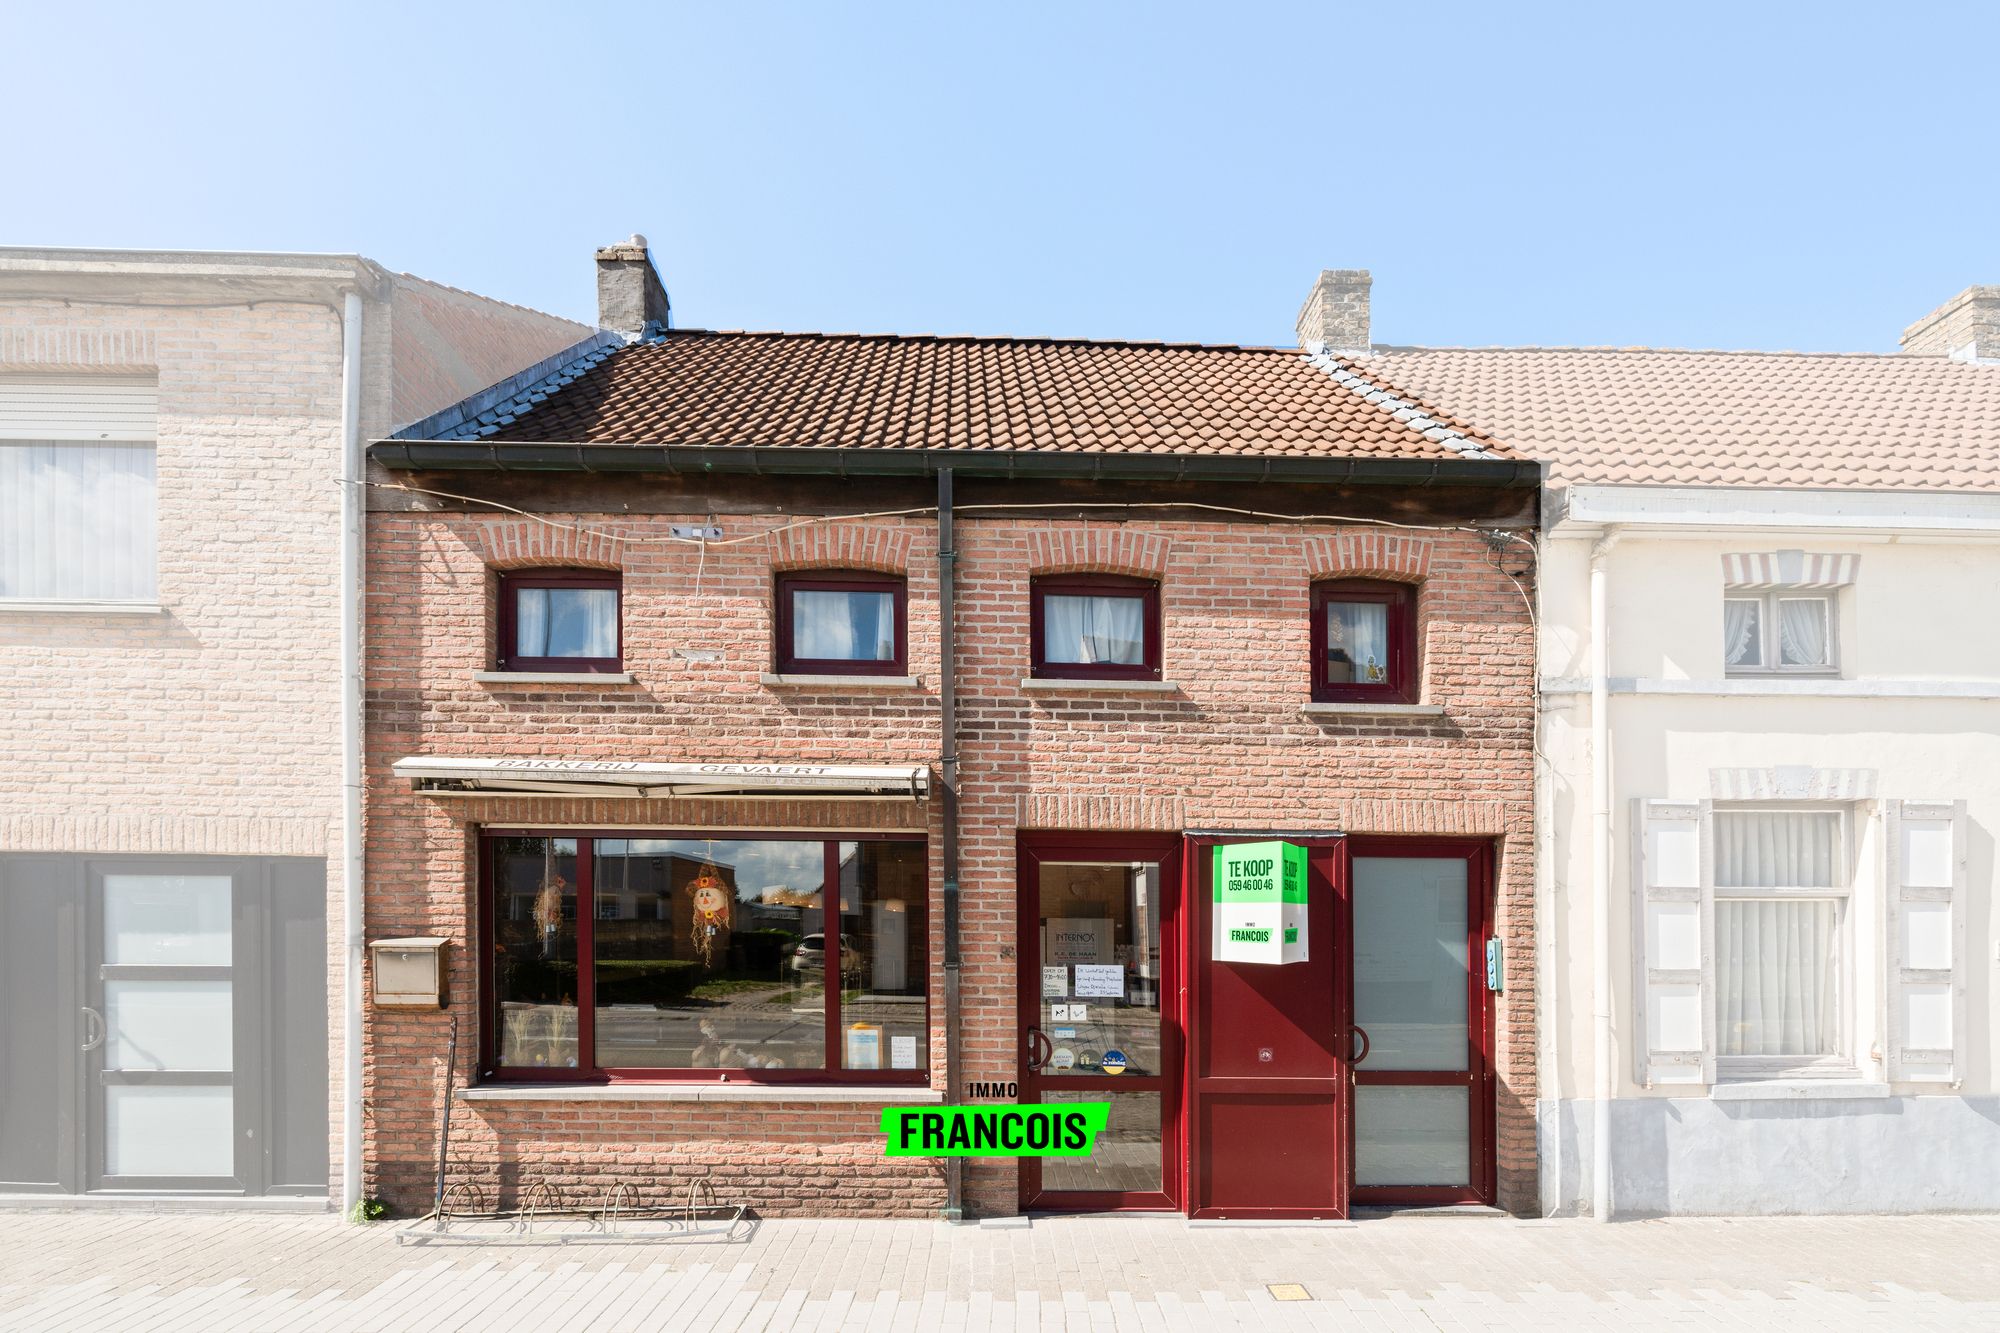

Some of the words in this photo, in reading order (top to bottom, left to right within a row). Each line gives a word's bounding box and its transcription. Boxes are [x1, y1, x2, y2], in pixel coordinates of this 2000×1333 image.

[494, 760, 639, 770] BAKKERIJ
[700, 764, 832, 775] GEVAERT
[1228, 861, 1241, 877] TE
[1243, 859, 1273, 877] KOOP
[1229, 879, 1242, 891] 059
[1243, 879, 1252, 890] 46
[1253, 879, 1263, 890] 00
[1263, 878, 1273, 890] 46
[1056, 933, 1095, 942] INTERNOS
[1231, 930, 1269, 942] FRANCOIS
